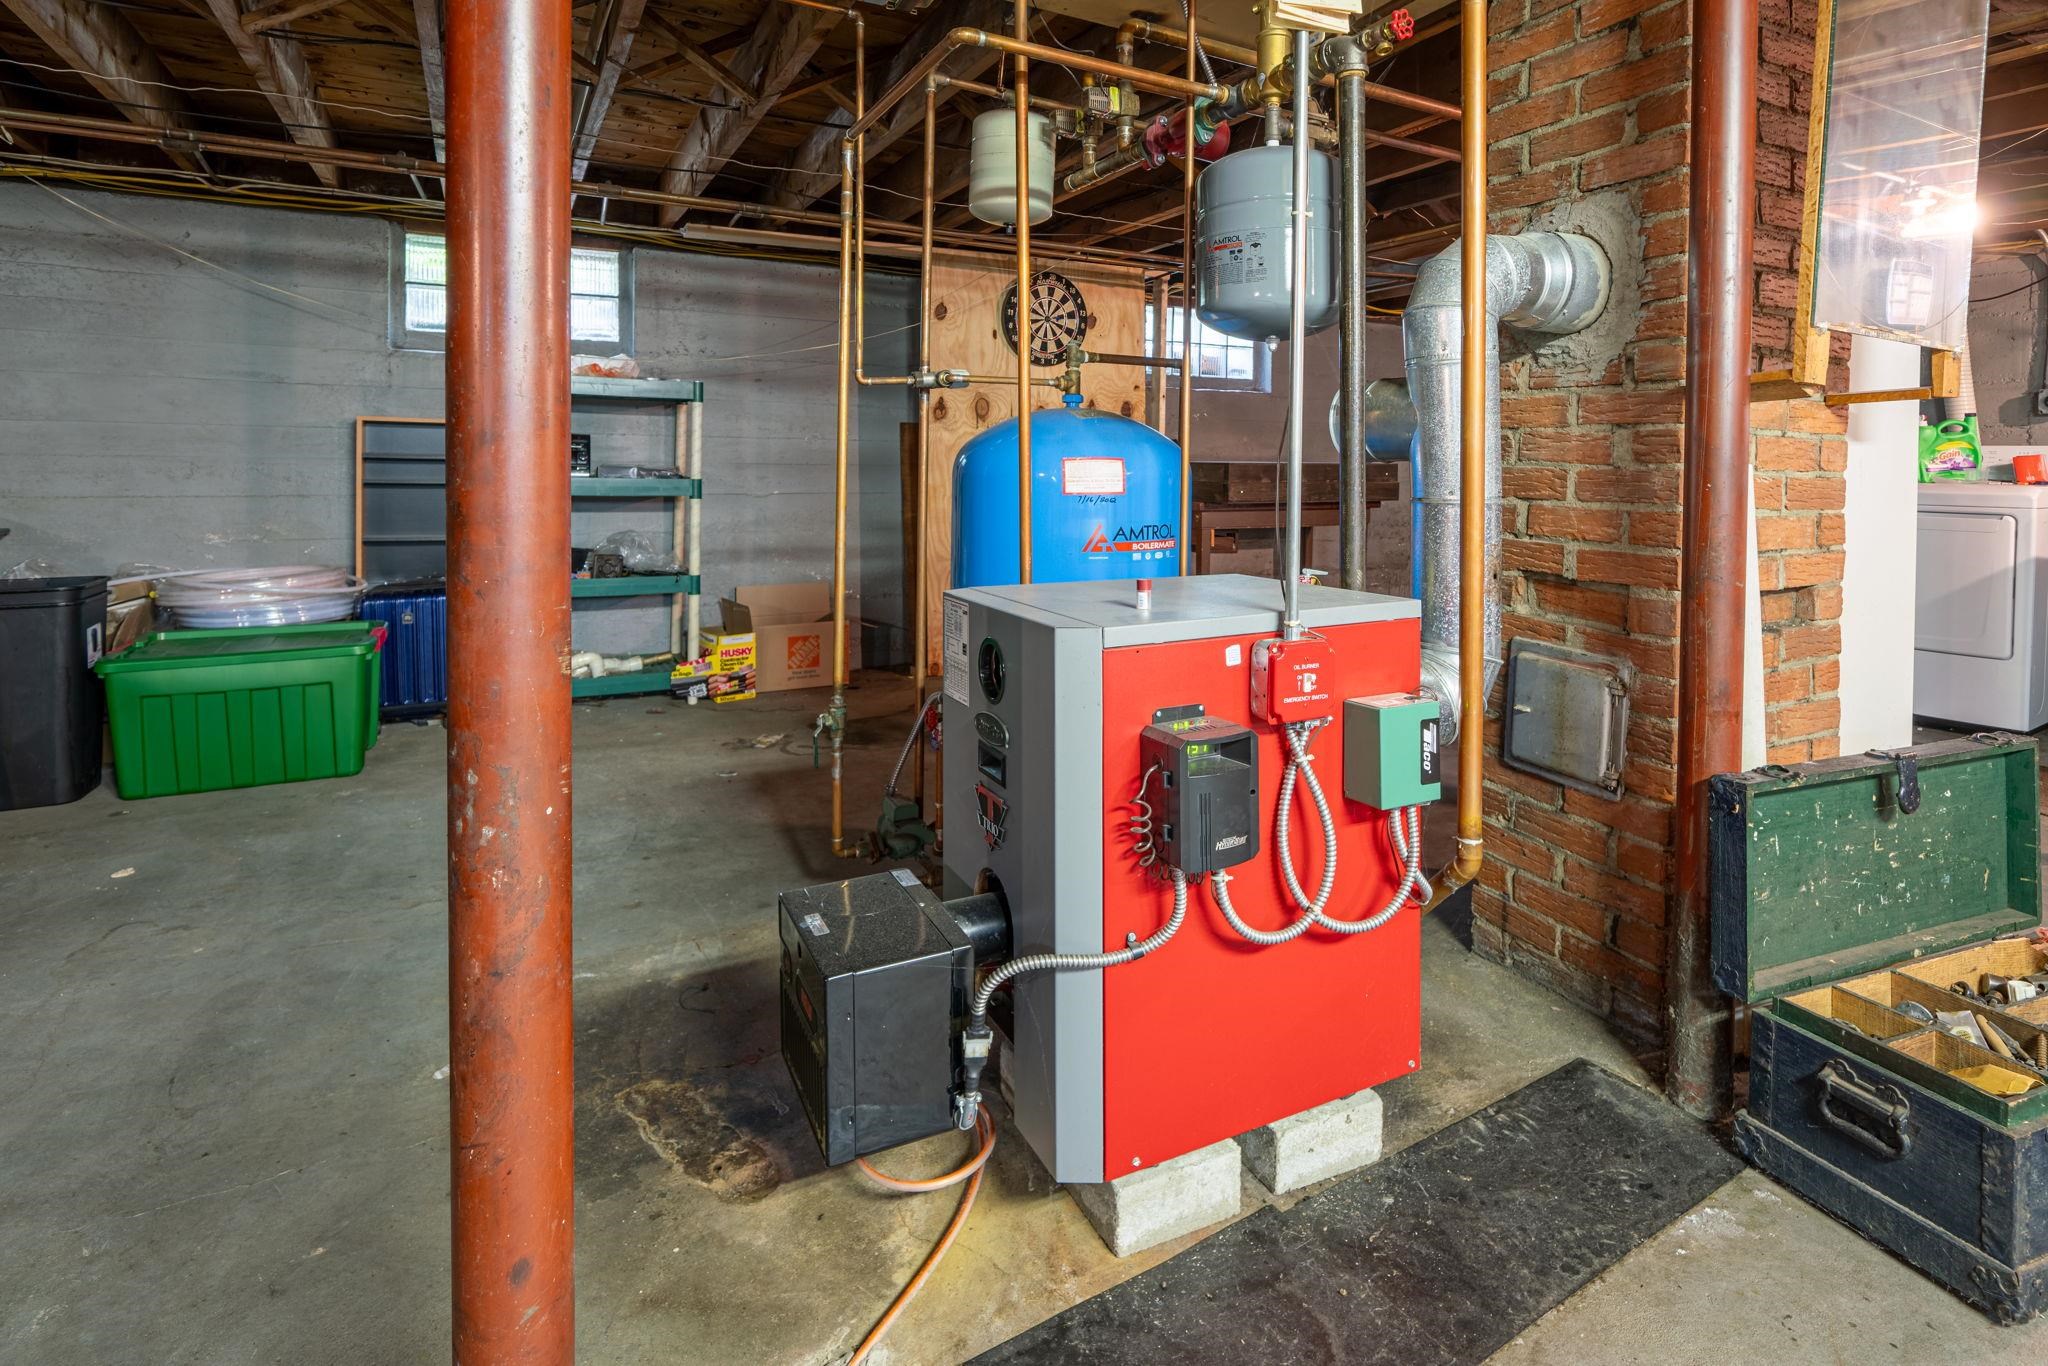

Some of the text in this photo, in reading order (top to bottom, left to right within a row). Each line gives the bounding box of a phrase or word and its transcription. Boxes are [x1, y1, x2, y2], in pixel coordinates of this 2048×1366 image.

[1213, 235, 1242, 246] AMTROL
[1939, 449, 1961, 460] Gain
[1112, 524, 1175, 541] AMTROL
[1132, 541, 1175, 551] BOILERMATE
[720, 646, 753, 657] HUSKY
[1283, 695, 1311, 704] EMERGENCY
[983, 817, 999, 837] TRIO
